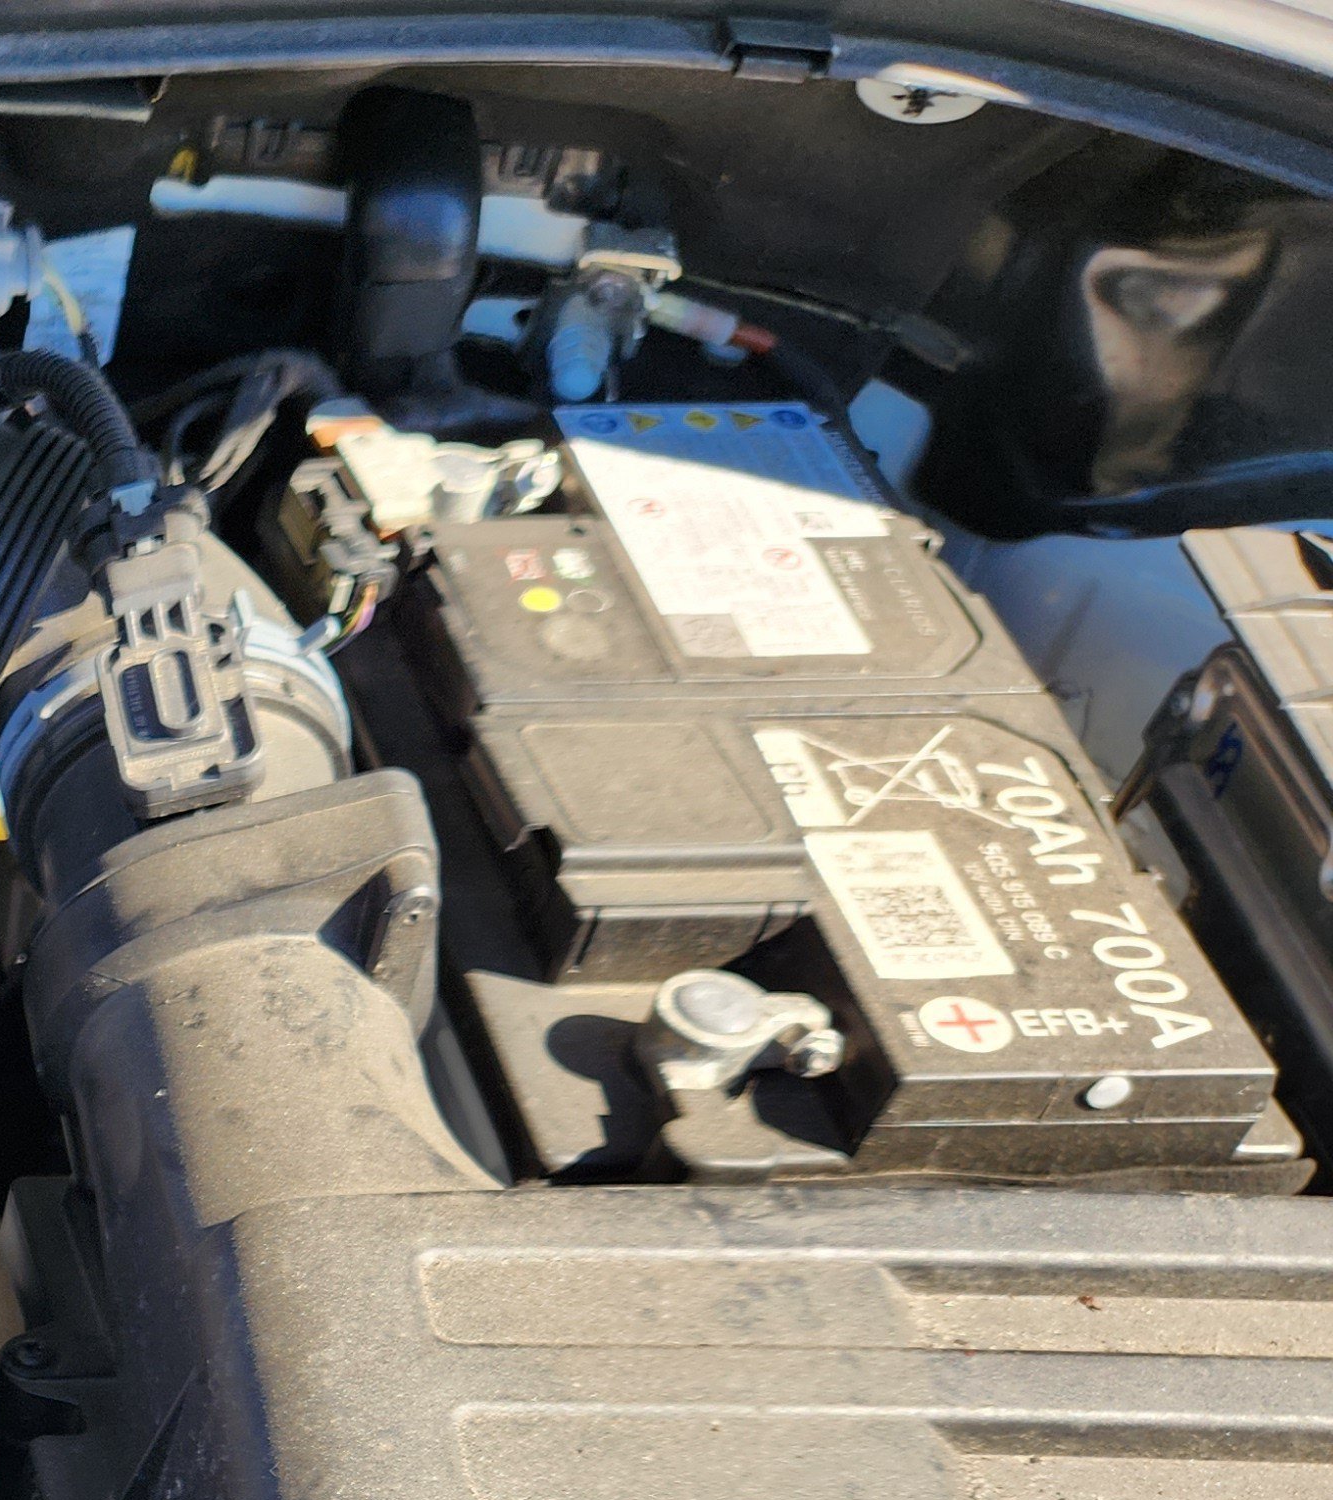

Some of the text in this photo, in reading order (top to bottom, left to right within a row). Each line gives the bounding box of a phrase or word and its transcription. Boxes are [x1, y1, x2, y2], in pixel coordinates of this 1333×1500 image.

[976, 757, 1213, 1049] 70Ah 700A
[1043, 945, 1070, 960] C
[1011, 1008, 1130, 1037] EFB+
